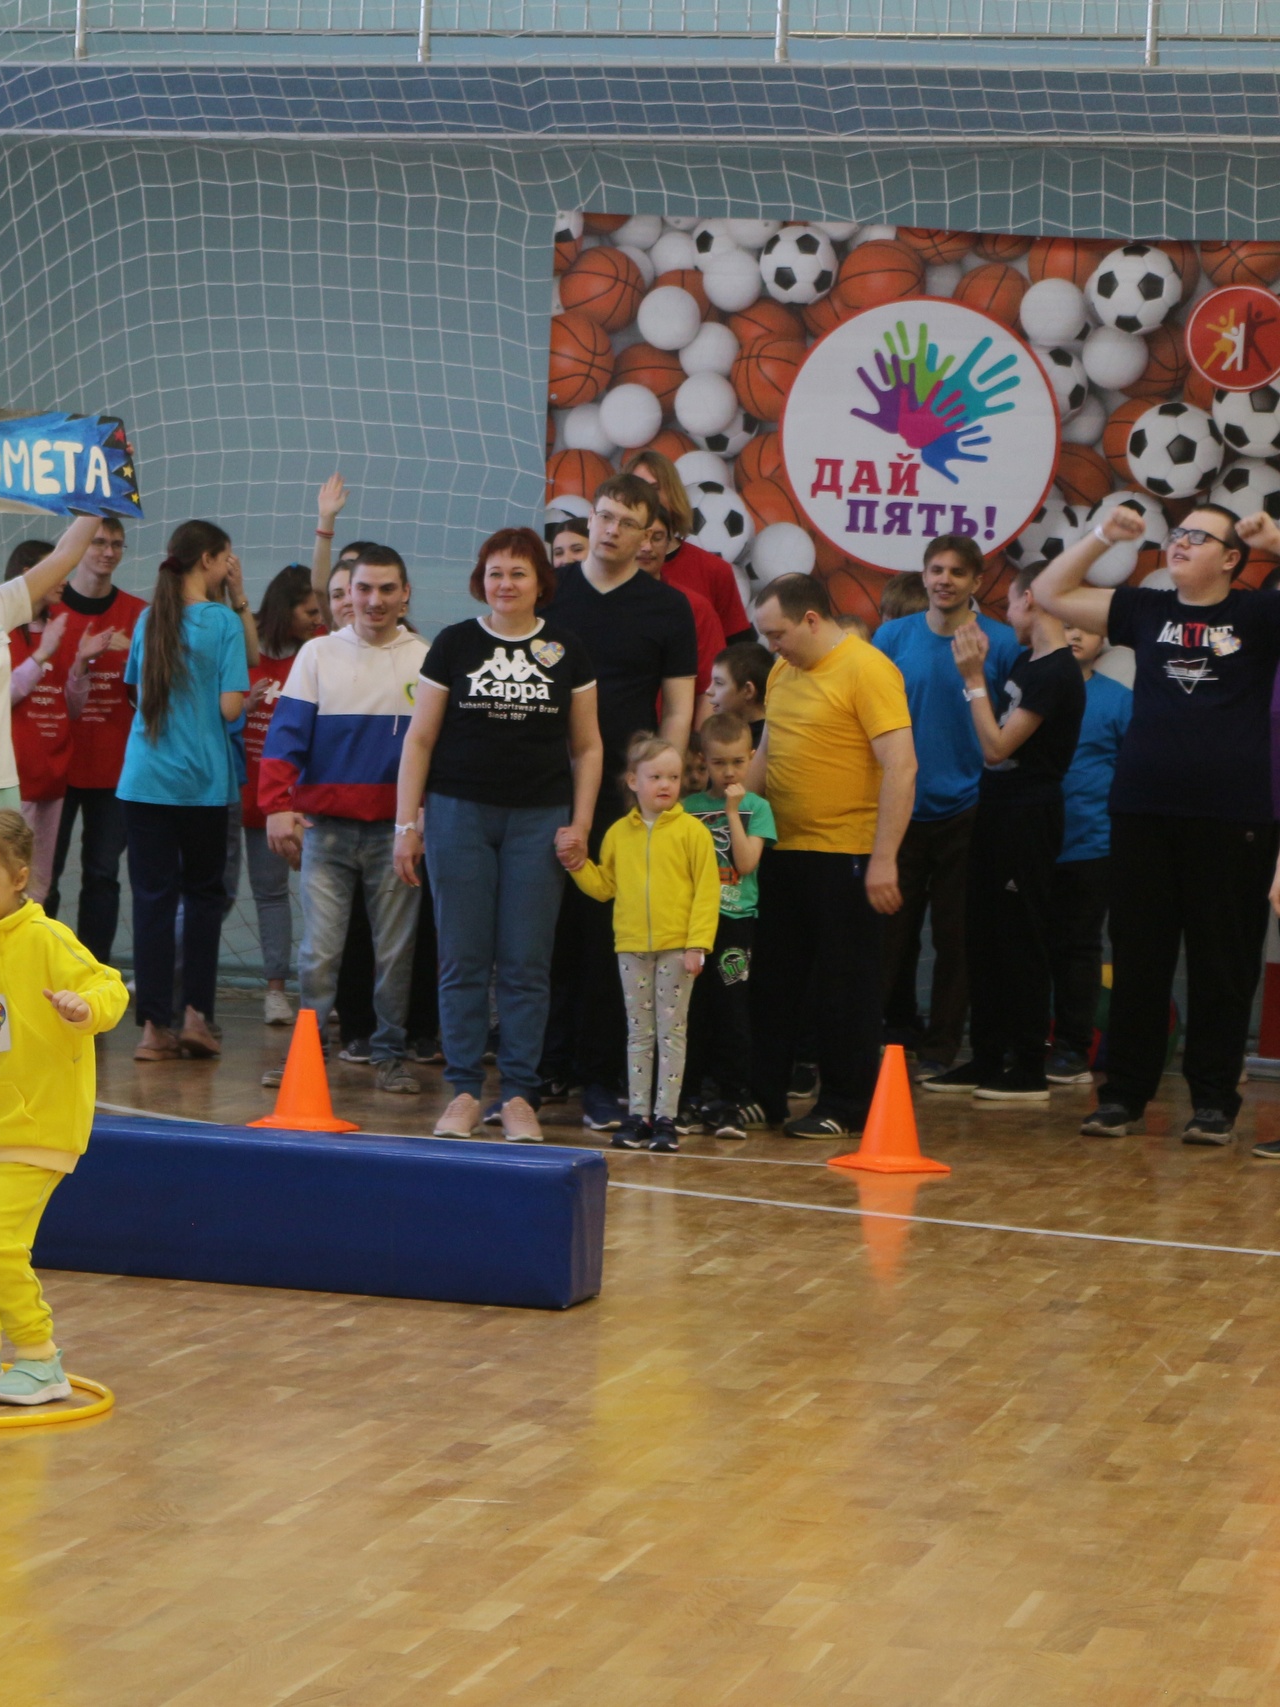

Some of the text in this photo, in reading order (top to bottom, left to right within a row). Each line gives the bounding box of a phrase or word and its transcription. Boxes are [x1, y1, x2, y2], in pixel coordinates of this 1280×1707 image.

[811, 453, 920, 499] ДАЙ
[845, 499, 997, 541] ПЯТЬ!
[468, 677, 550, 704] Kappa
[487, 711, 527, 721] Since 1967
[493, 702, 537, 712] Sportswear
[539, 704, 560, 714] Brand
